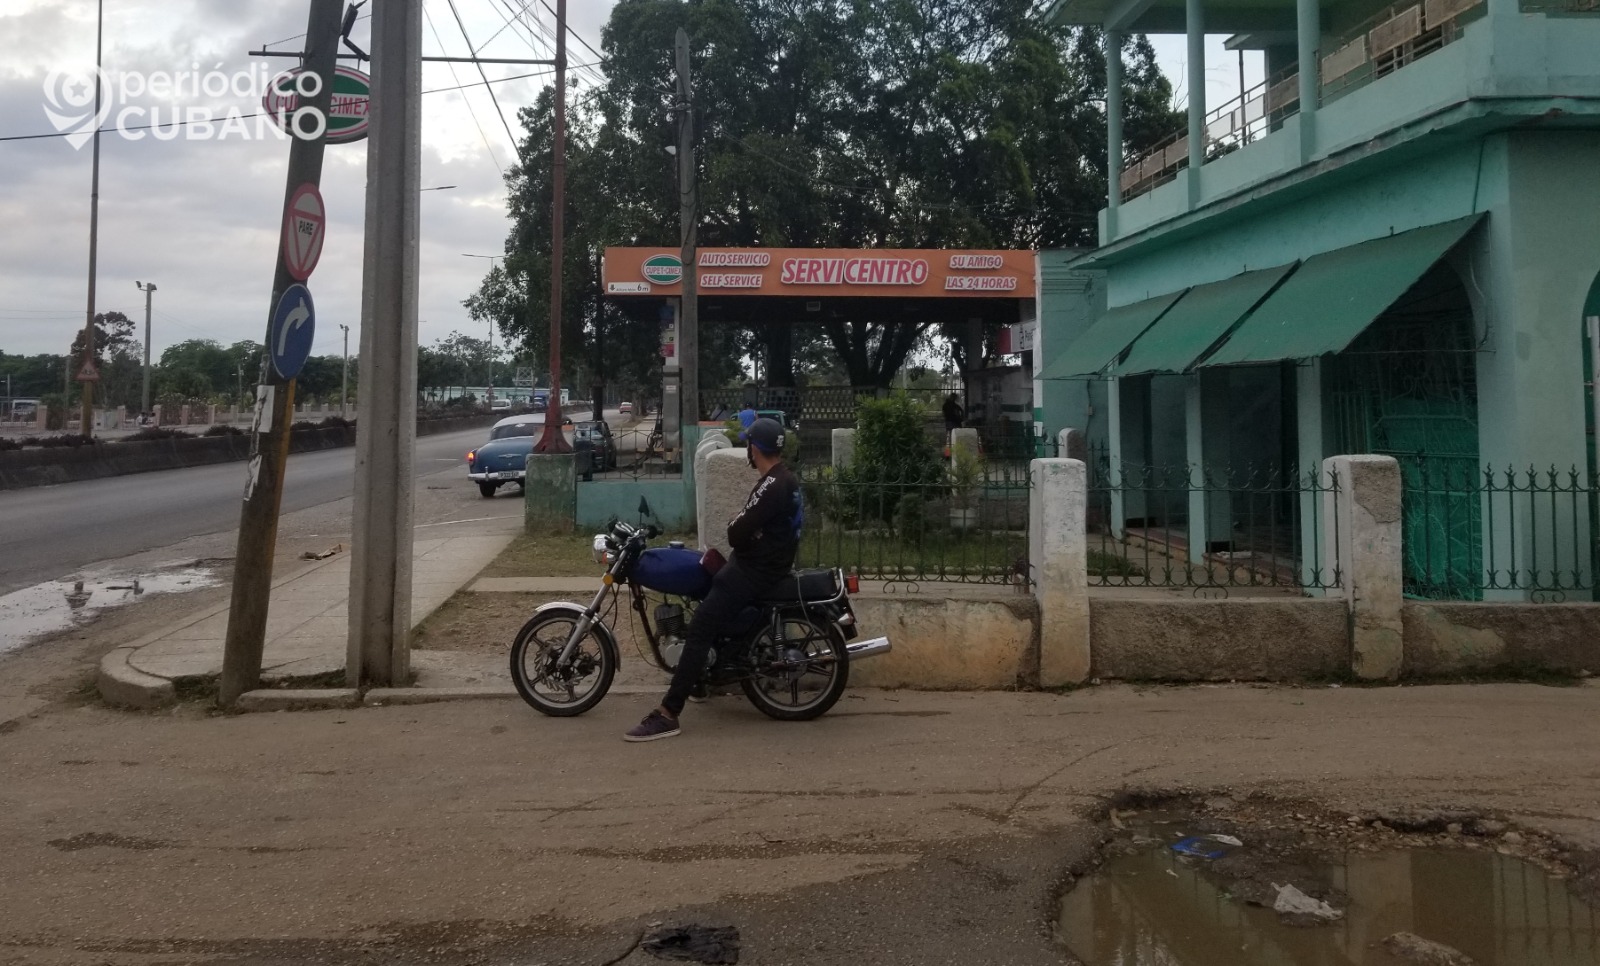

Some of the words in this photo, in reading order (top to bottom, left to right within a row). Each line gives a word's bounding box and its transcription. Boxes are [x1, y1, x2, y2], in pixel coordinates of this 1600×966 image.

[298, 220, 314, 235] PARE
[951, 256, 965, 267] SU
[967, 256, 1002, 267] AMIGO
[782, 259, 928, 284] SERVICENTRO
[702, 275, 722, 286] SELF
[723, 275, 761, 286] SERVICE
[947, 276, 964, 289] LAS
[967, 277, 979, 289] 24
[981, 277, 1016, 289] HORAS
